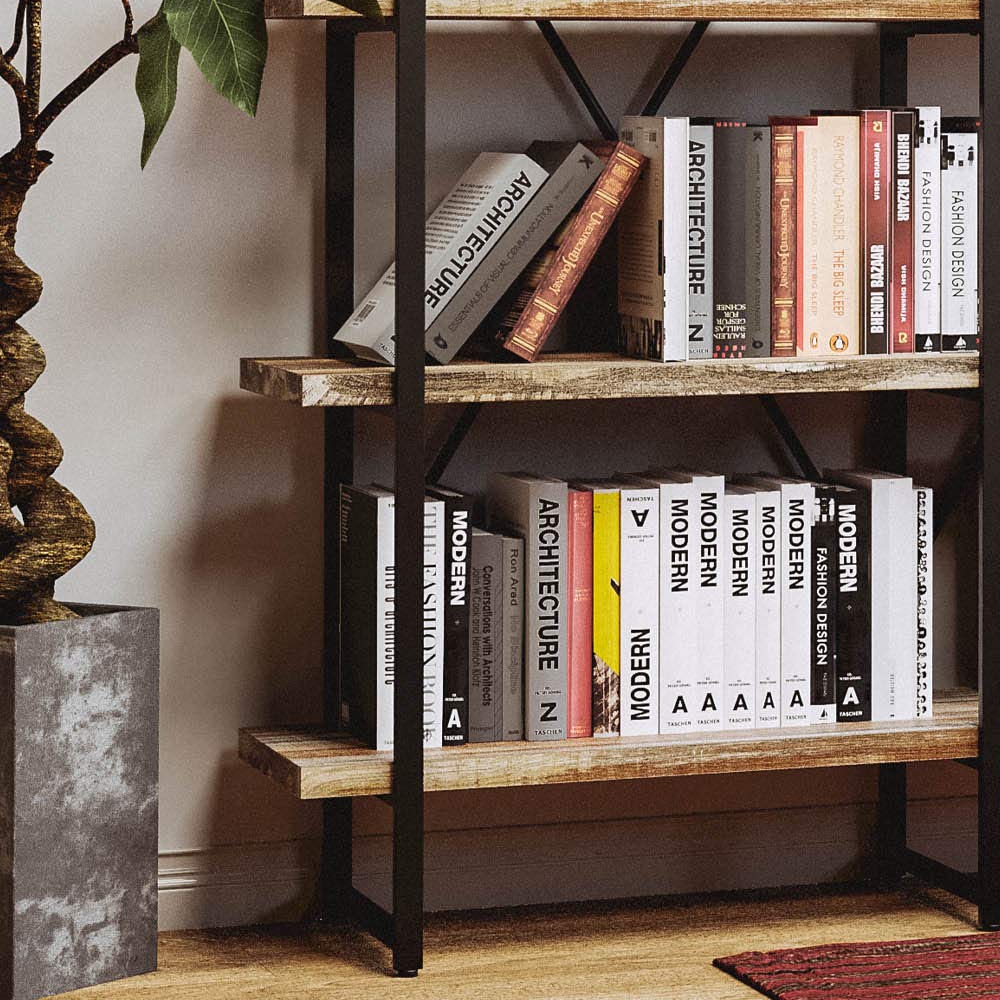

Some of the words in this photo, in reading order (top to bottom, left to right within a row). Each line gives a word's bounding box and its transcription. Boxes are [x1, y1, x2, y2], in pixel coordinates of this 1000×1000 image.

[897, 134, 909, 175] BHENDI
[426, 171, 532, 309] ARCHITECTURE
[689, 140, 705, 295] ARCHITECTURE
[897, 179, 909, 221] BAZAAR
[922, 172, 931, 233] FASHION
[952, 191, 964, 246] FASHION
[870, 245, 884, 287] BAZAAR
[922, 240, 931, 292] DESIGN
[952, 250, 964, 297] DESIGN
[870, 291, 884, 334] BHENDI
[451, 511, 468, 605] MODERN
[671, 500, 688, 592] MODERN
[701, 493, 717, 587] MODERN
[732, 510, 748, 596] MODERN
[762, 506, 775, 594] MODERN
[789, 499, 804, 589] MODERN
[817, 548, 827, 608] FASHION
[839, 505, 857, 592] MODERN
[539, 499, 559, 671] ARCHITECTURE
[631, 629, 650, 720] MODERN
[817, 614, 827, 665] DESIGN
